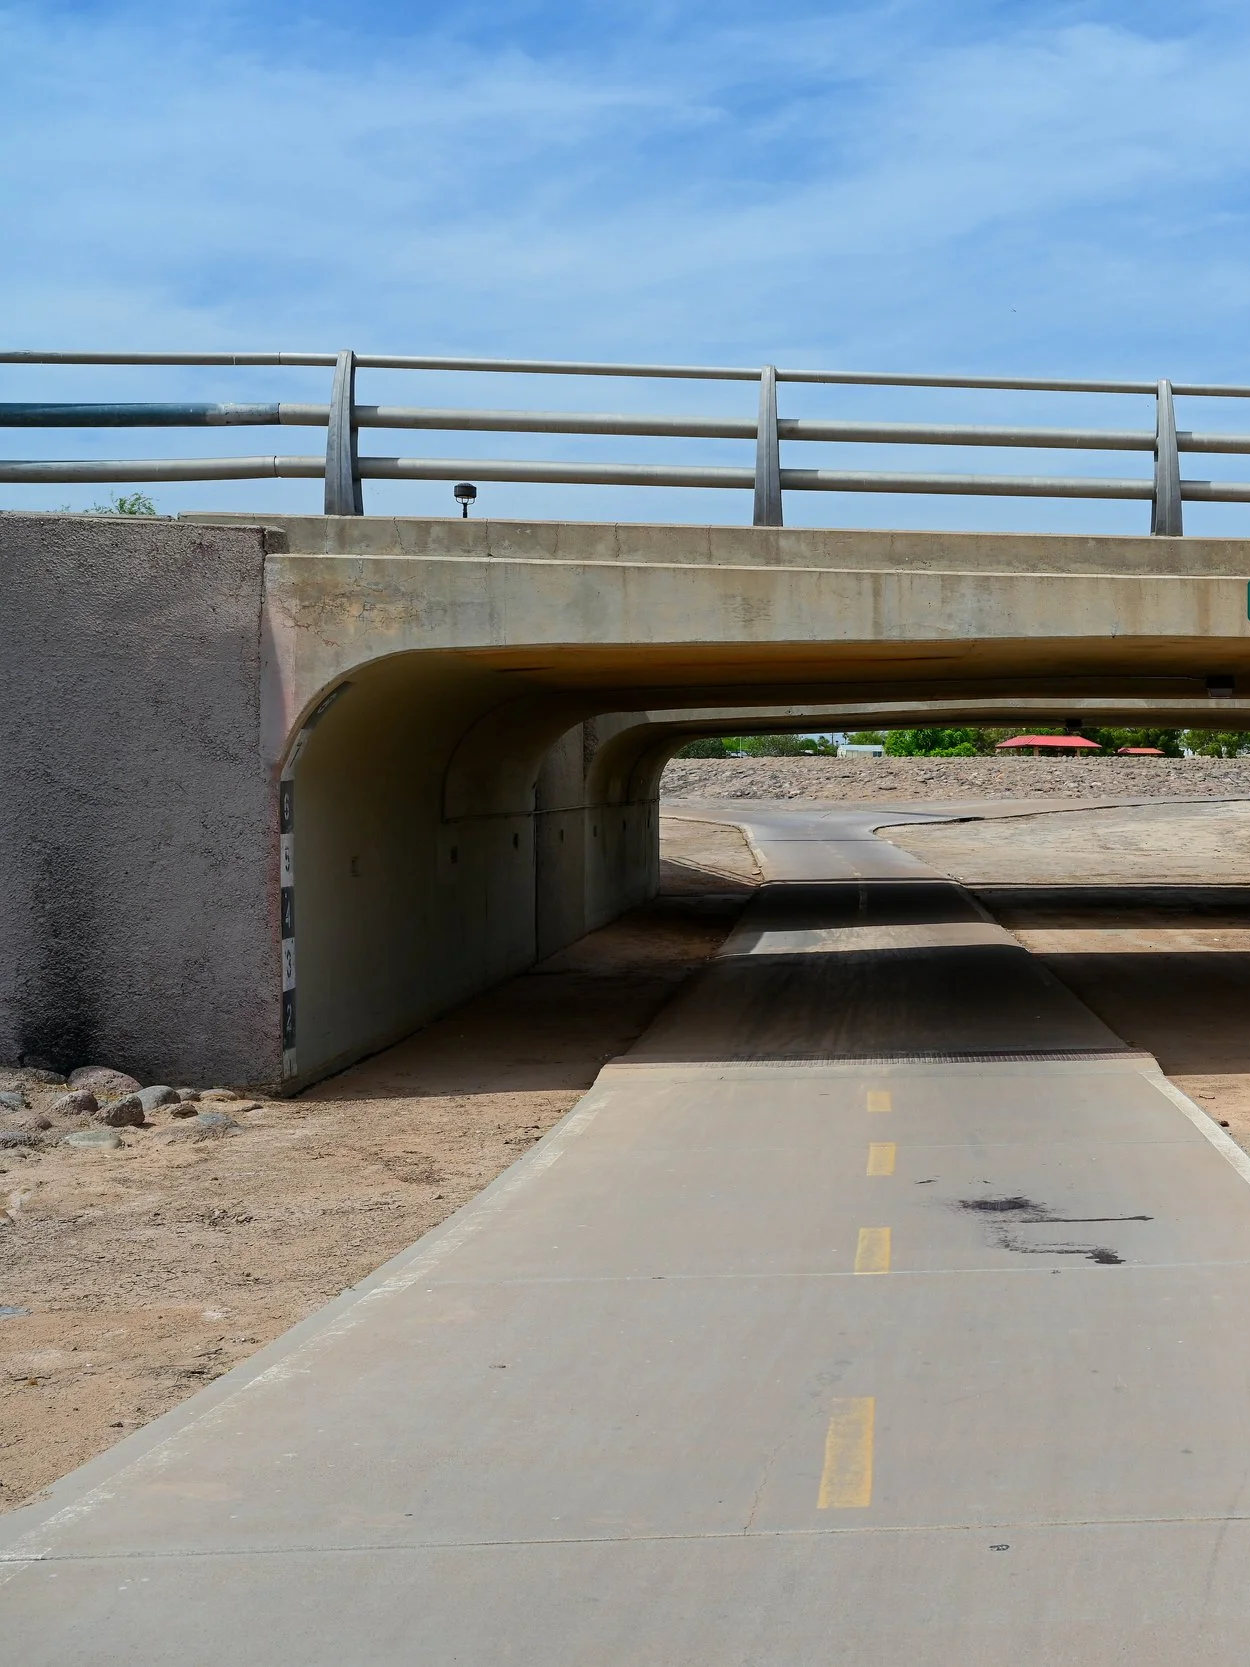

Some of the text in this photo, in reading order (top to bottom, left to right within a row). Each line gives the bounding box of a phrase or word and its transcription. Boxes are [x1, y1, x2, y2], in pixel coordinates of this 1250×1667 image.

[284, 792, 290, 820] 6
[284, 846, 291, 872] 5
[285, 949, 292, 978] 3
[286, 1003, 293, 1031] 2
